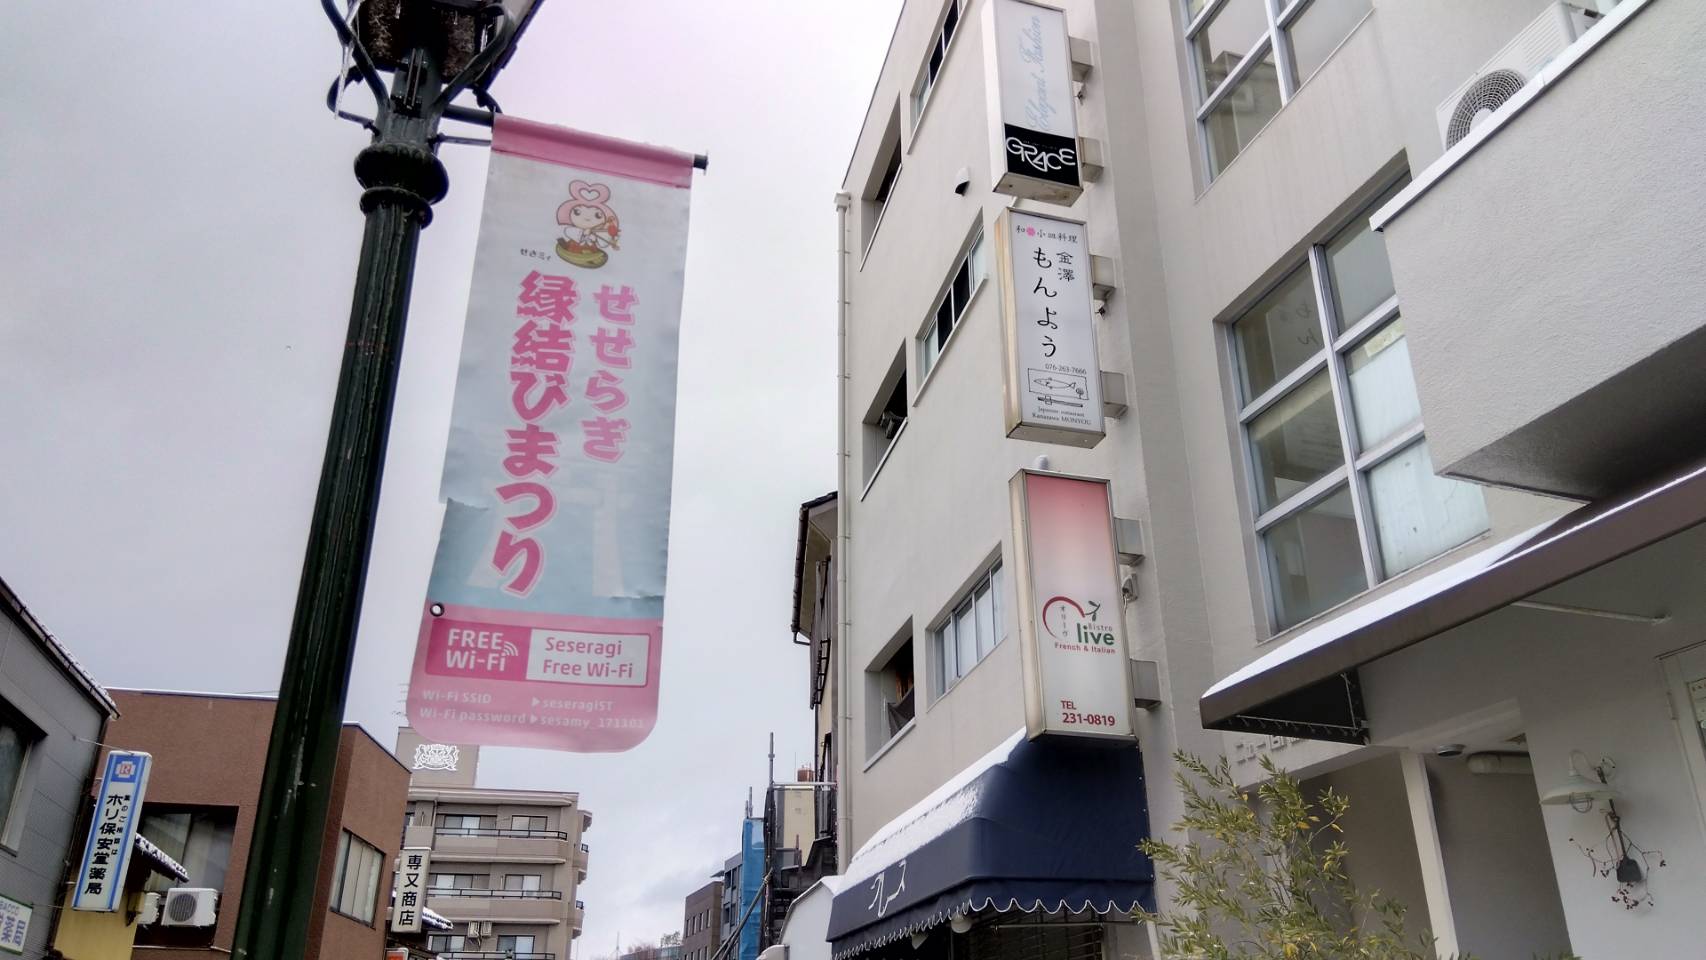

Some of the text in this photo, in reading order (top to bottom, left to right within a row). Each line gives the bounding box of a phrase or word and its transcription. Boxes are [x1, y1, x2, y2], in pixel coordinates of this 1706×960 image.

[1006, 137, 1076, 172] GRACE
[1056, 251, 1075, 282] 金澤
[1033, 247, 1058, 358] もんよう
[580, 284, 640, 463] せせらぎ
[490, 270, 579, 599] 縁結びまつり
[447, 628, 504, 651] FREE
[545, 637, 623, 658] Seseragi
[1055, 641, 1116, 654] French & Italian
[446, 651, 507, 672] Wi-Fi
[543, 659, 634, 678] Free Wi-Fi
[422, 690, 492, 704] Wi-Fi SSID
[1061, 700, 1077, 710] TEL
[419, 707, 526, 724] Wi-Fi password
[1062, 712, 1116, 727] 231-0819
[85, 794, 124, 895] ホリ保安堂薬局
[398, 854, 422, 926] 専又商店
